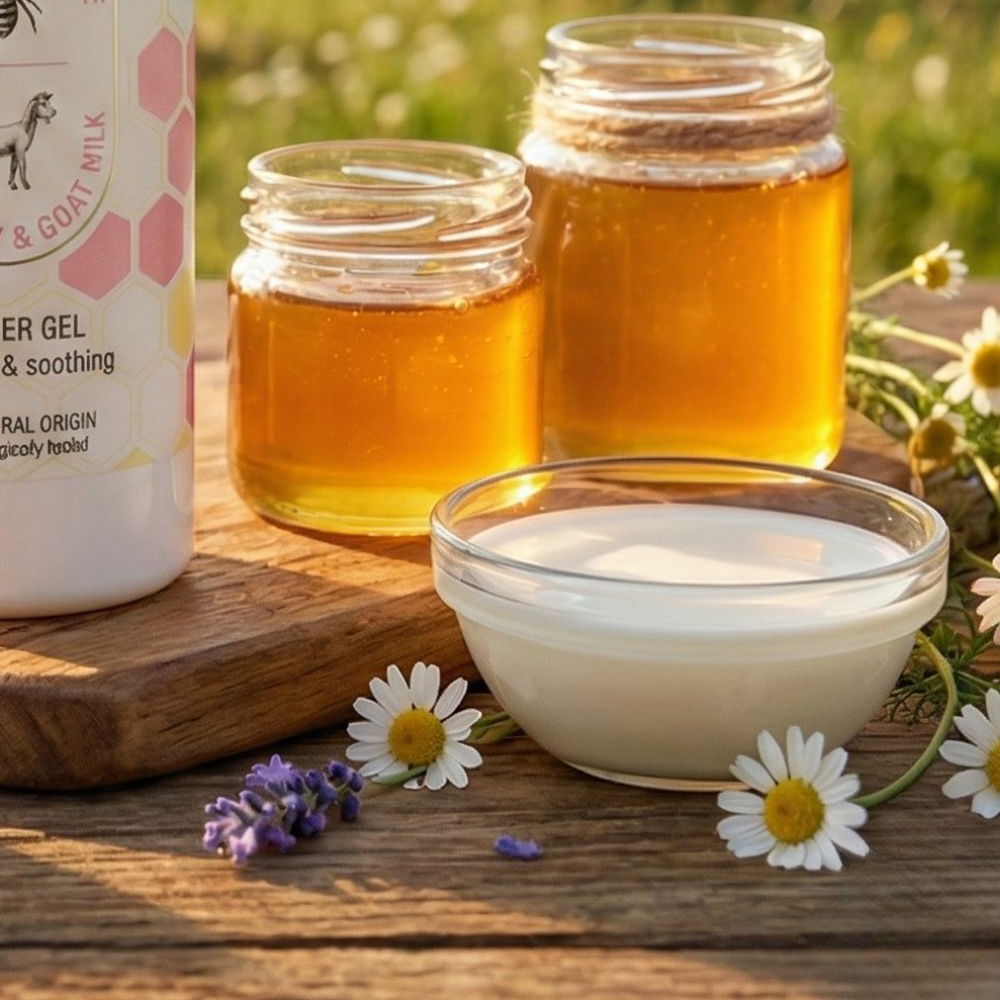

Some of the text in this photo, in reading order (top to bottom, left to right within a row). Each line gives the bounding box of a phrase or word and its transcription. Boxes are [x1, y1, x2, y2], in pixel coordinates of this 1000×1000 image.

[13, 225, 32, 250] &
[37, 179, 93, 240] GOAT
[81, 111, 106, 172] MILK
[41, 314, 86, 340] GEL
[2, 354, 18, 377] &
[26, 349, 115, 375] soothing
[40, 411, 97, 431] ORIGIN
